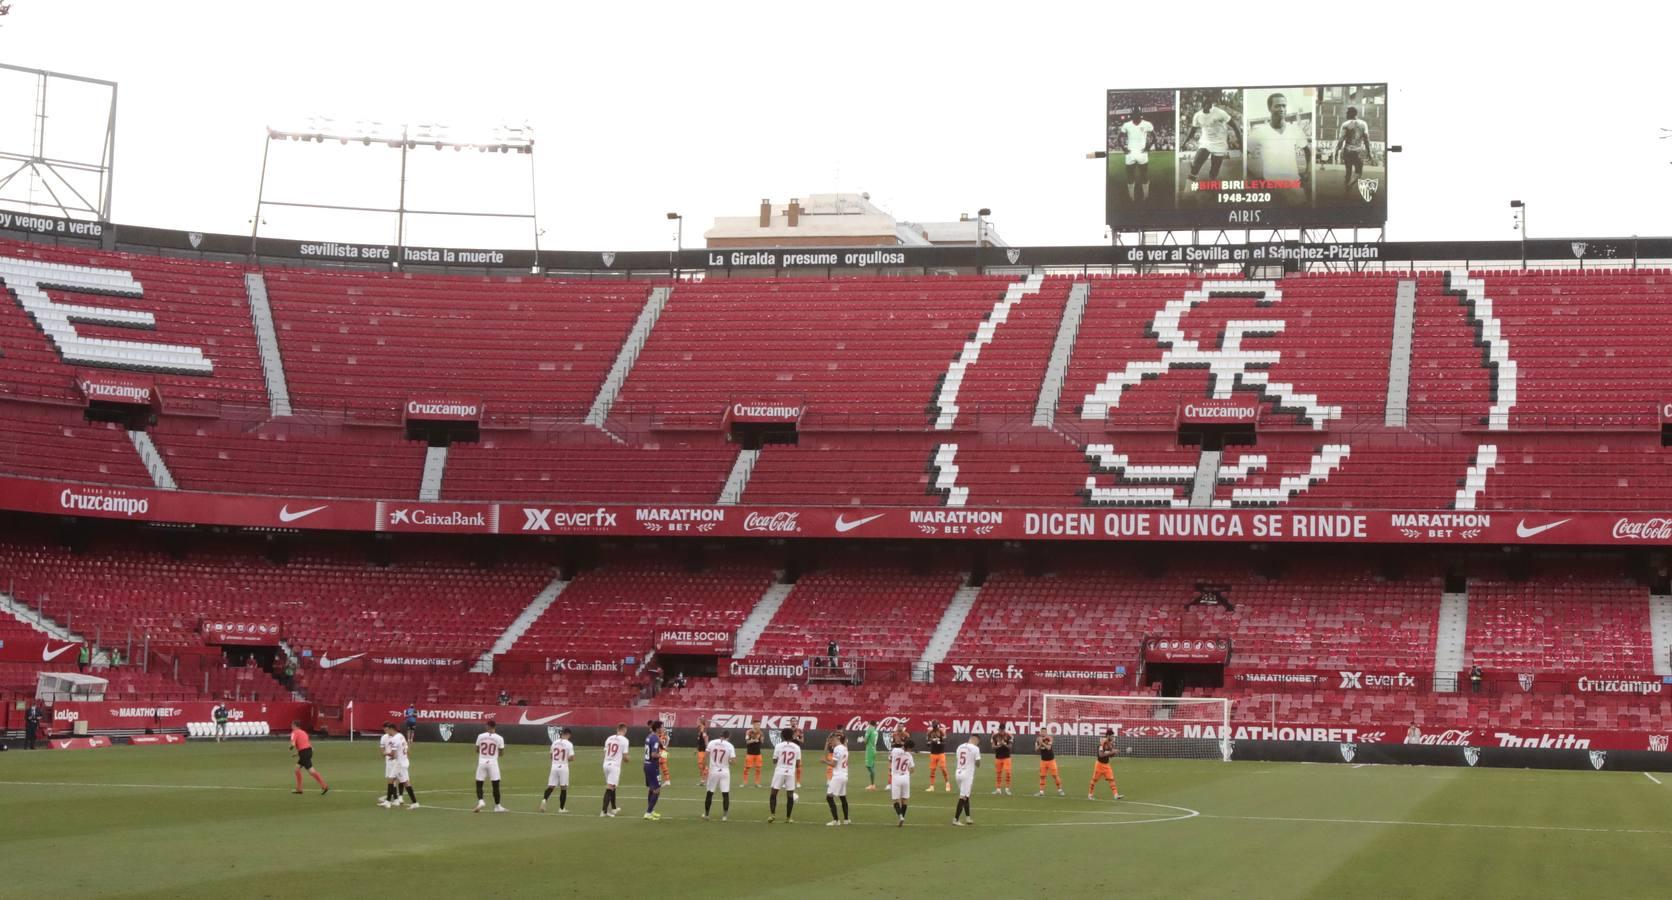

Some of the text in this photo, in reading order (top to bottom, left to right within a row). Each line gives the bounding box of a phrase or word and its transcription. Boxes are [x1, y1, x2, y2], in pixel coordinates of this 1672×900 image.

[1218, 192, 1271, 203] 1948-2020
[1229, 209, 1261, 223] AIRIS
[15, 216, 53, 231] vengo
[57, 221, 65, 232] a
[69, 222, 102, 236] verte
[300, 242, 390, 259] sevillista seré
[404, 247, 504, 263] hasta la muerte
[1127, 245, 1379, 261] de ver al Sevilla en el Sánchez-Pizjuán
[709, 251, 905, 267] La Giralda presume orgullosa
[83, 381, 149, 399] Cruzcampo
[408, 401, 477, 416] Cruzcampo
[733, 403, 800, 419] Cruzcampo
[1184, 403, 1255, 420] Cruzcampo
[61, 488, 148, 515] Cruzcampo
[411, 509, 485, 526] CaixaBank
[554, 508, 617, 527] everfx
[635, 508, 724, 521] MARATHON
[743, 510, 801, 532] Coca-Cola
[909, 510, 1003, 524] MARATHON
[1391, 514, 1490, 527] MARATHON
[668, 523, 690, 531] BET
[943, 525, 967, 534] BET
[1025, 512, 1368, 538] DICEN QUE NUNCA SE RINDE
[1612, 517, 1672, 540] Coca-Cola
[1428, 530, 1453, 538] BET
[660, 631, 729, 642] ¡HAZTE SOCIO!
[567, 659, 618, 672] CaixaBank
[730, 661, 803, 678] Cruzcampo
[1365, 672, 1415, 687] everfx
[1577, 676, 1662, 695] Cruzcampo
[54, 709, 79, 721] LaLiga
[404, 710, 484, 720] ARATHONBET
[953, 719, 1123, 737] MARATHONBET
[1183, 724, 1358, 743] MARATHONBET
[481, 742, 497, 756] 20
[553, 748, 566, 761] 21
[607, 743, 619, 757] 19
[713, 749, 725, 763] 17
[781, 751, 795, 766] 12
[895, 757, 909, 772] 16
[960, 751, 967, 766] 5
